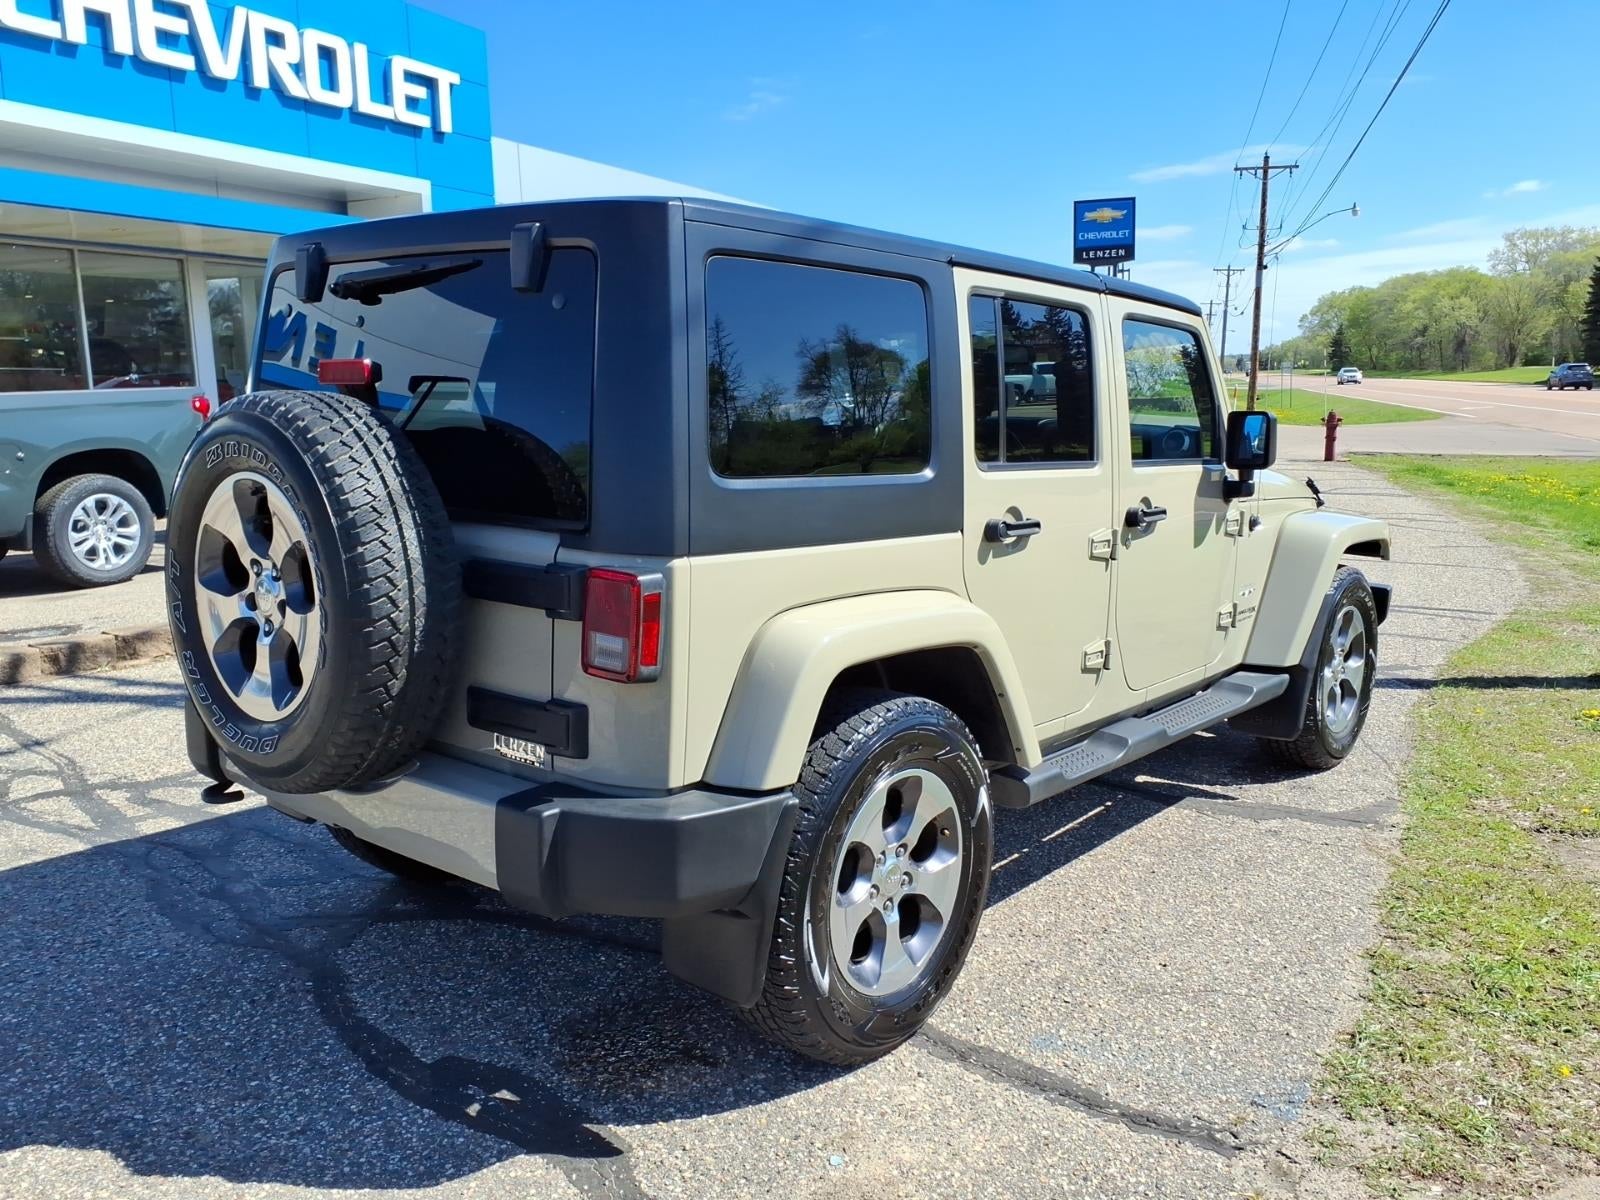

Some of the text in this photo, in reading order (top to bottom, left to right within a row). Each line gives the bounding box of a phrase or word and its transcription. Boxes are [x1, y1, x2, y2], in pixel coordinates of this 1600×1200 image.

[1079, 230, 1130, 240] CHEVROLET
[1083, 249, 1125, 259] LENZEN
[168, 548, 280, 754] DUELER A/T
[494, 732, 545, 761] LENZEN
